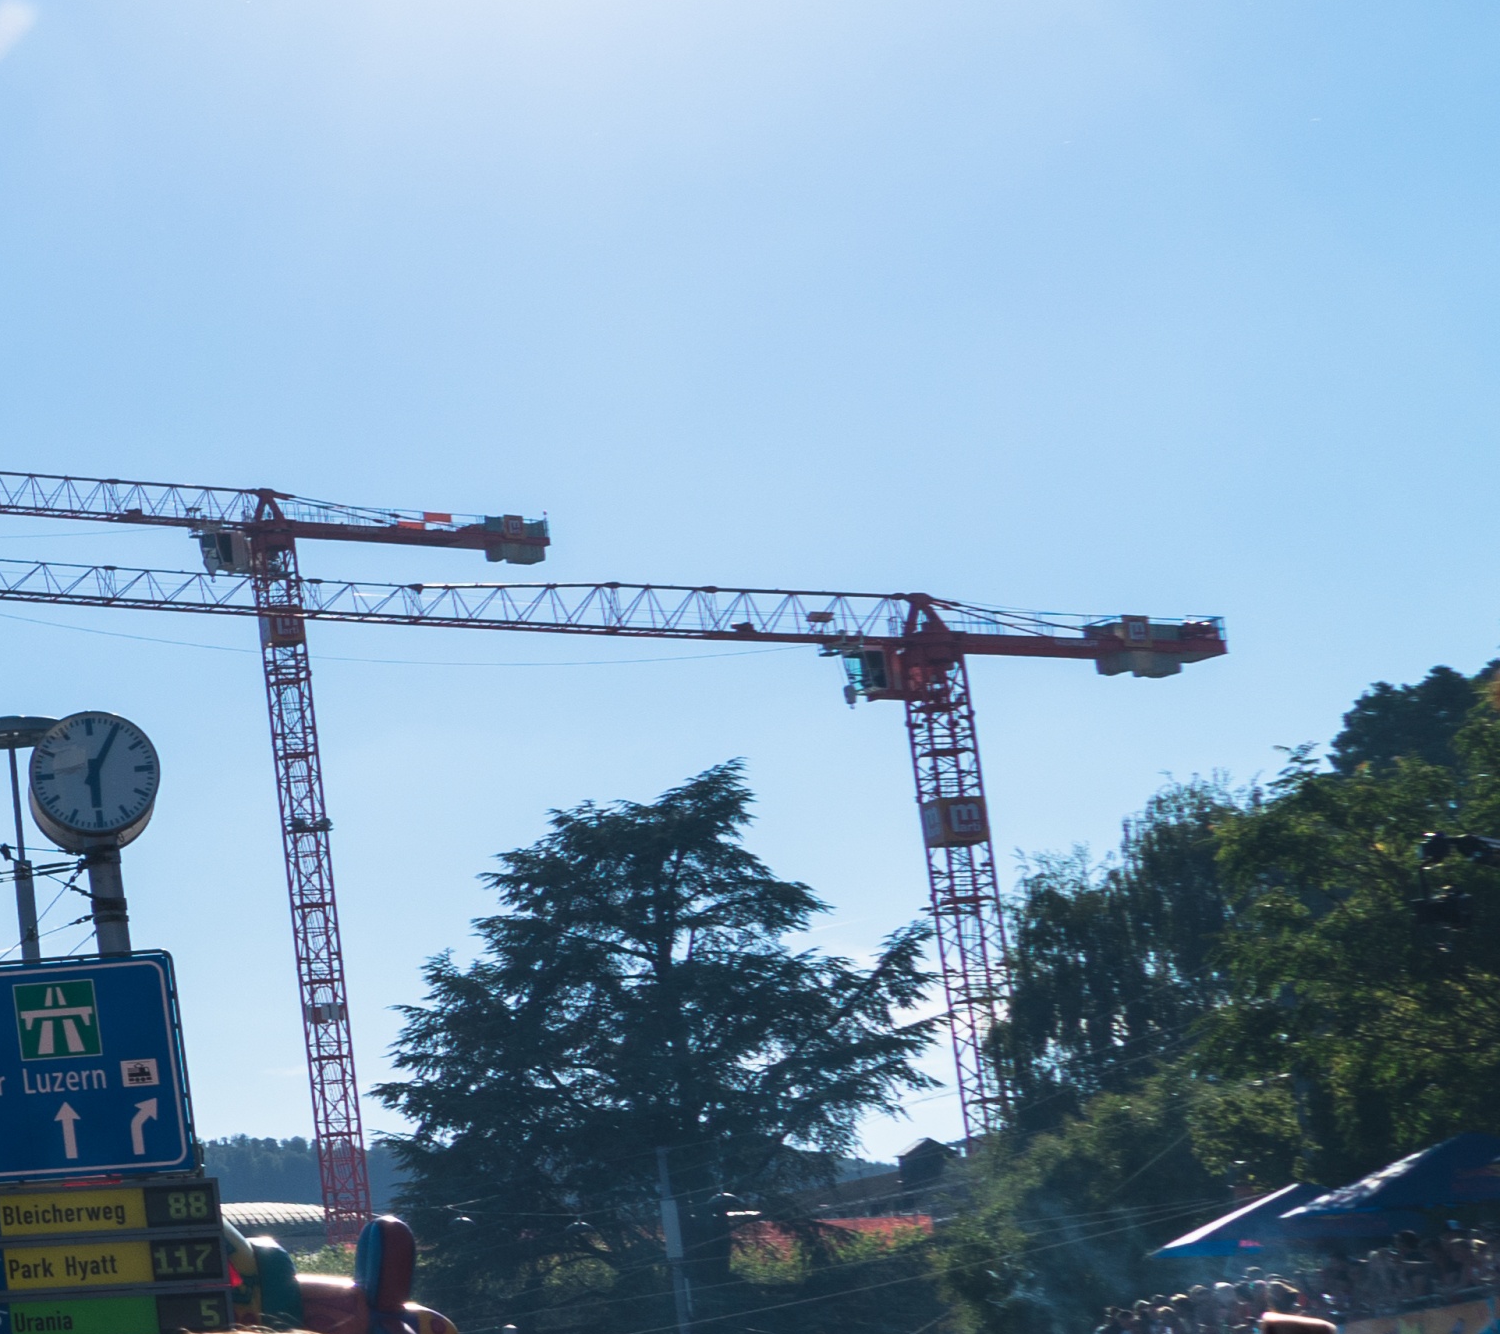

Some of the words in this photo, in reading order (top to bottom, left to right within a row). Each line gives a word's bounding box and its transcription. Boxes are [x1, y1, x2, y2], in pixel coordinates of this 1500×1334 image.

[22, 1068, 107, 1094] Luzern
[2, 1204, 126, 1226] Bleicherweg
[167, 1191, 208, 1220] 88
[8, 1258, 55, 1280] Park
[65, 1255, 118, 1281] Hyatt
[155, 1244, 213, 1275] 117
[14, 1311, 73, 1332] Urania
[200, 1299, 220, 1327] 5
